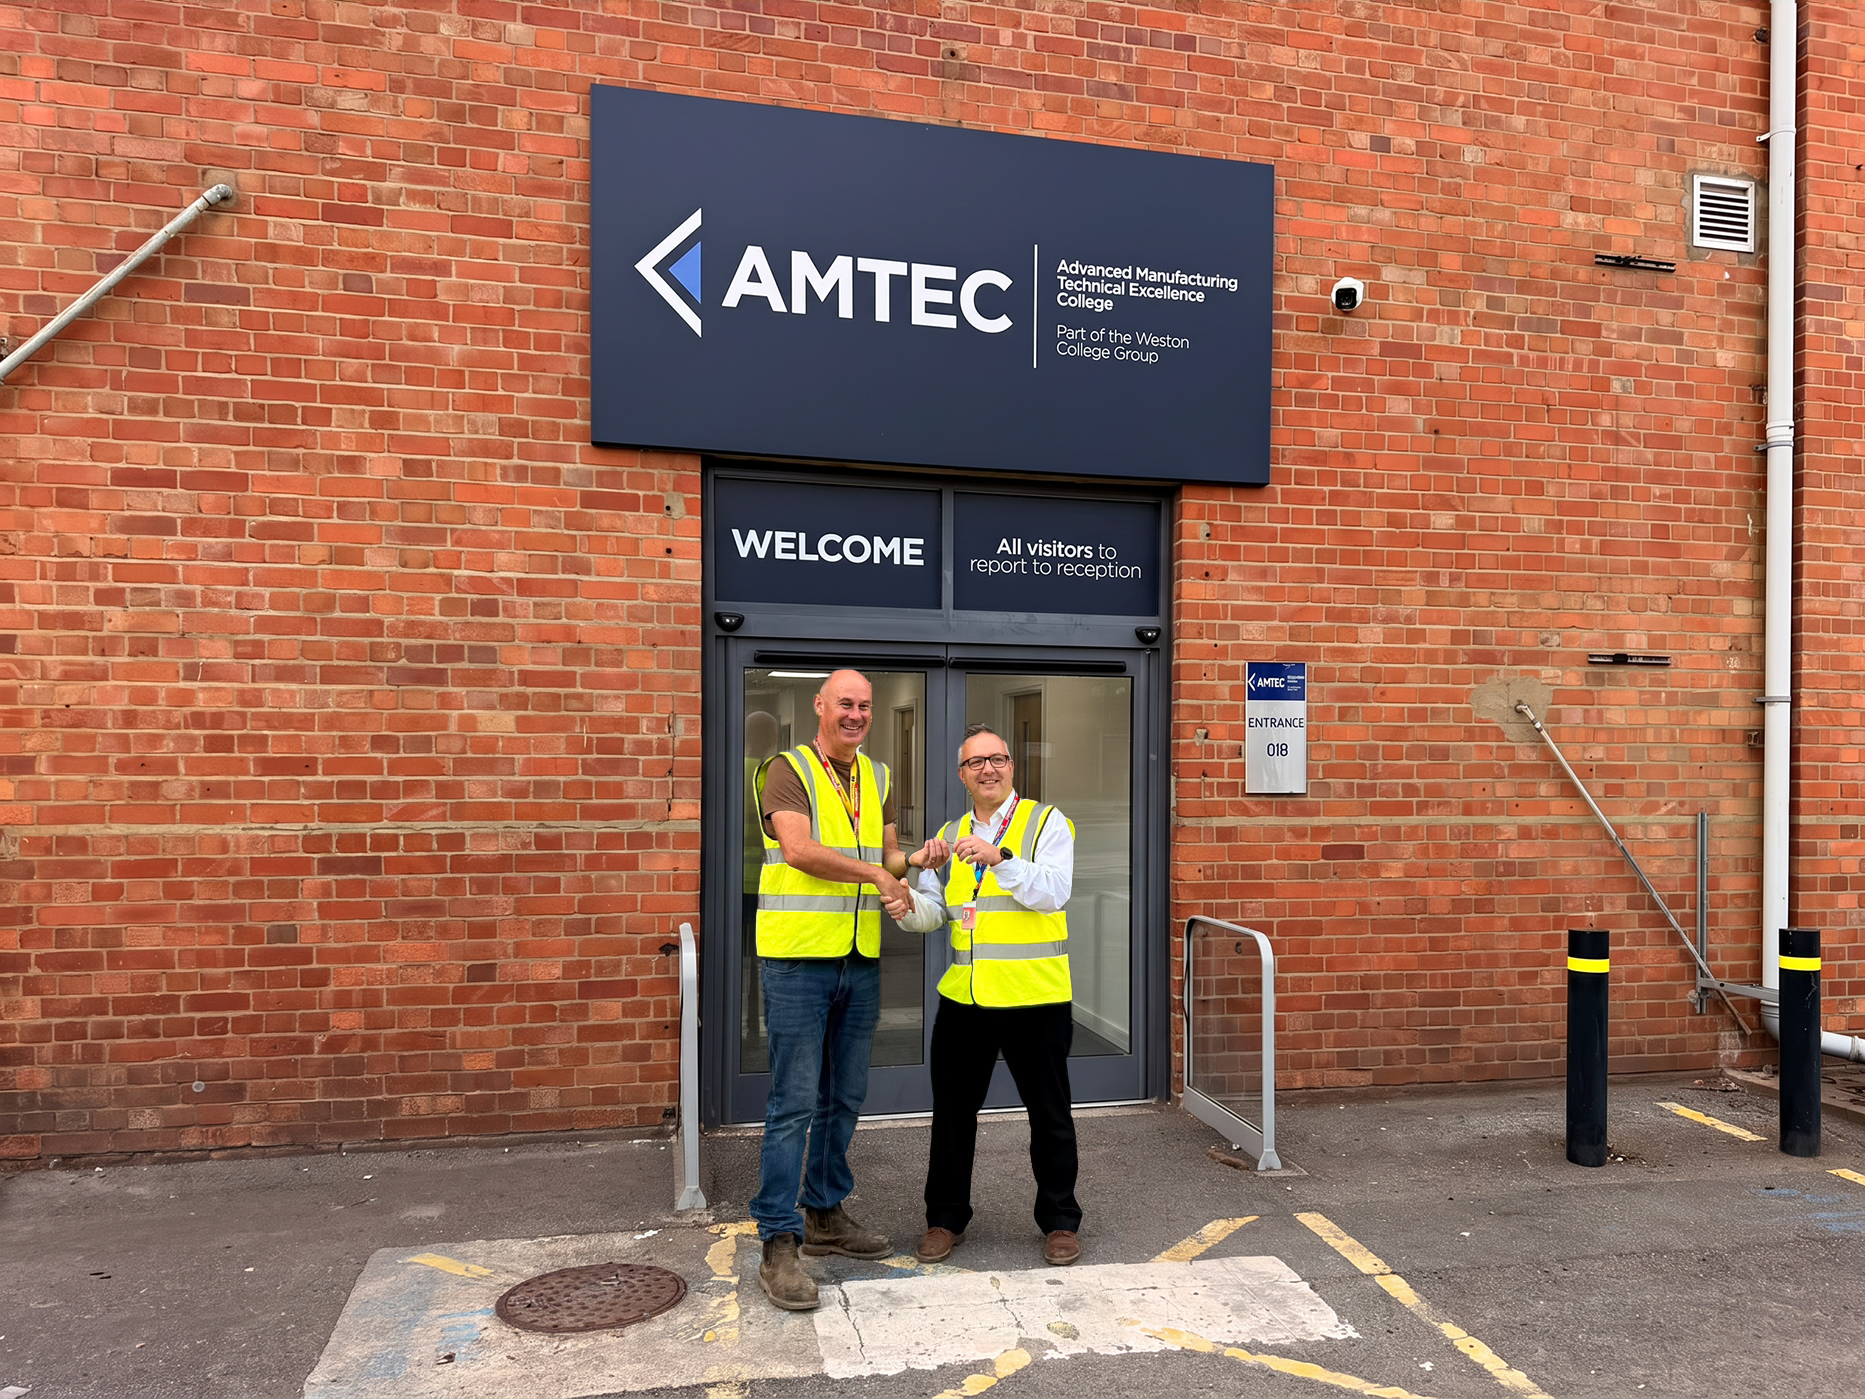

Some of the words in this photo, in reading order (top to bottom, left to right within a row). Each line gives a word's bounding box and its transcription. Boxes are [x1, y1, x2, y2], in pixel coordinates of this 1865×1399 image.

[1056, 259, 1133, 280] Advanced
[1135, 266, 1239, 292] Manufacturing
[721, 244, 1014, 334] AMTEC
[1056, 275, 1126, 296] Technical
[1128, 282, 1206, 303] Excellence
[1056, 292, 1114, 312] College
[1056, 324, 1086, 341] Part
[1089, 328, 1106, 342] of
[1108, 329, 1132, 345] the
[1135, 331, 1190, 349] Weston
[1056, 341, 1111, 361] College
[1113, 345, 1159, 365] Group
[731, 528, 925, 566] WELCOME
[996, 537, 1023, 556] All
[1026, 539, 1094, 560] visitors
[1098, 543, 1118, 560] to
[970, 557, 1028, 577] report
[1032, 559, 1053, 575] to
[1056, 562, 1143, 582] reception
[1257, 677, 1285, 688] AMTEC
[1248, 717, 1304, 728] ENTRANCE
[1267, 743, 1288, 757] 018
